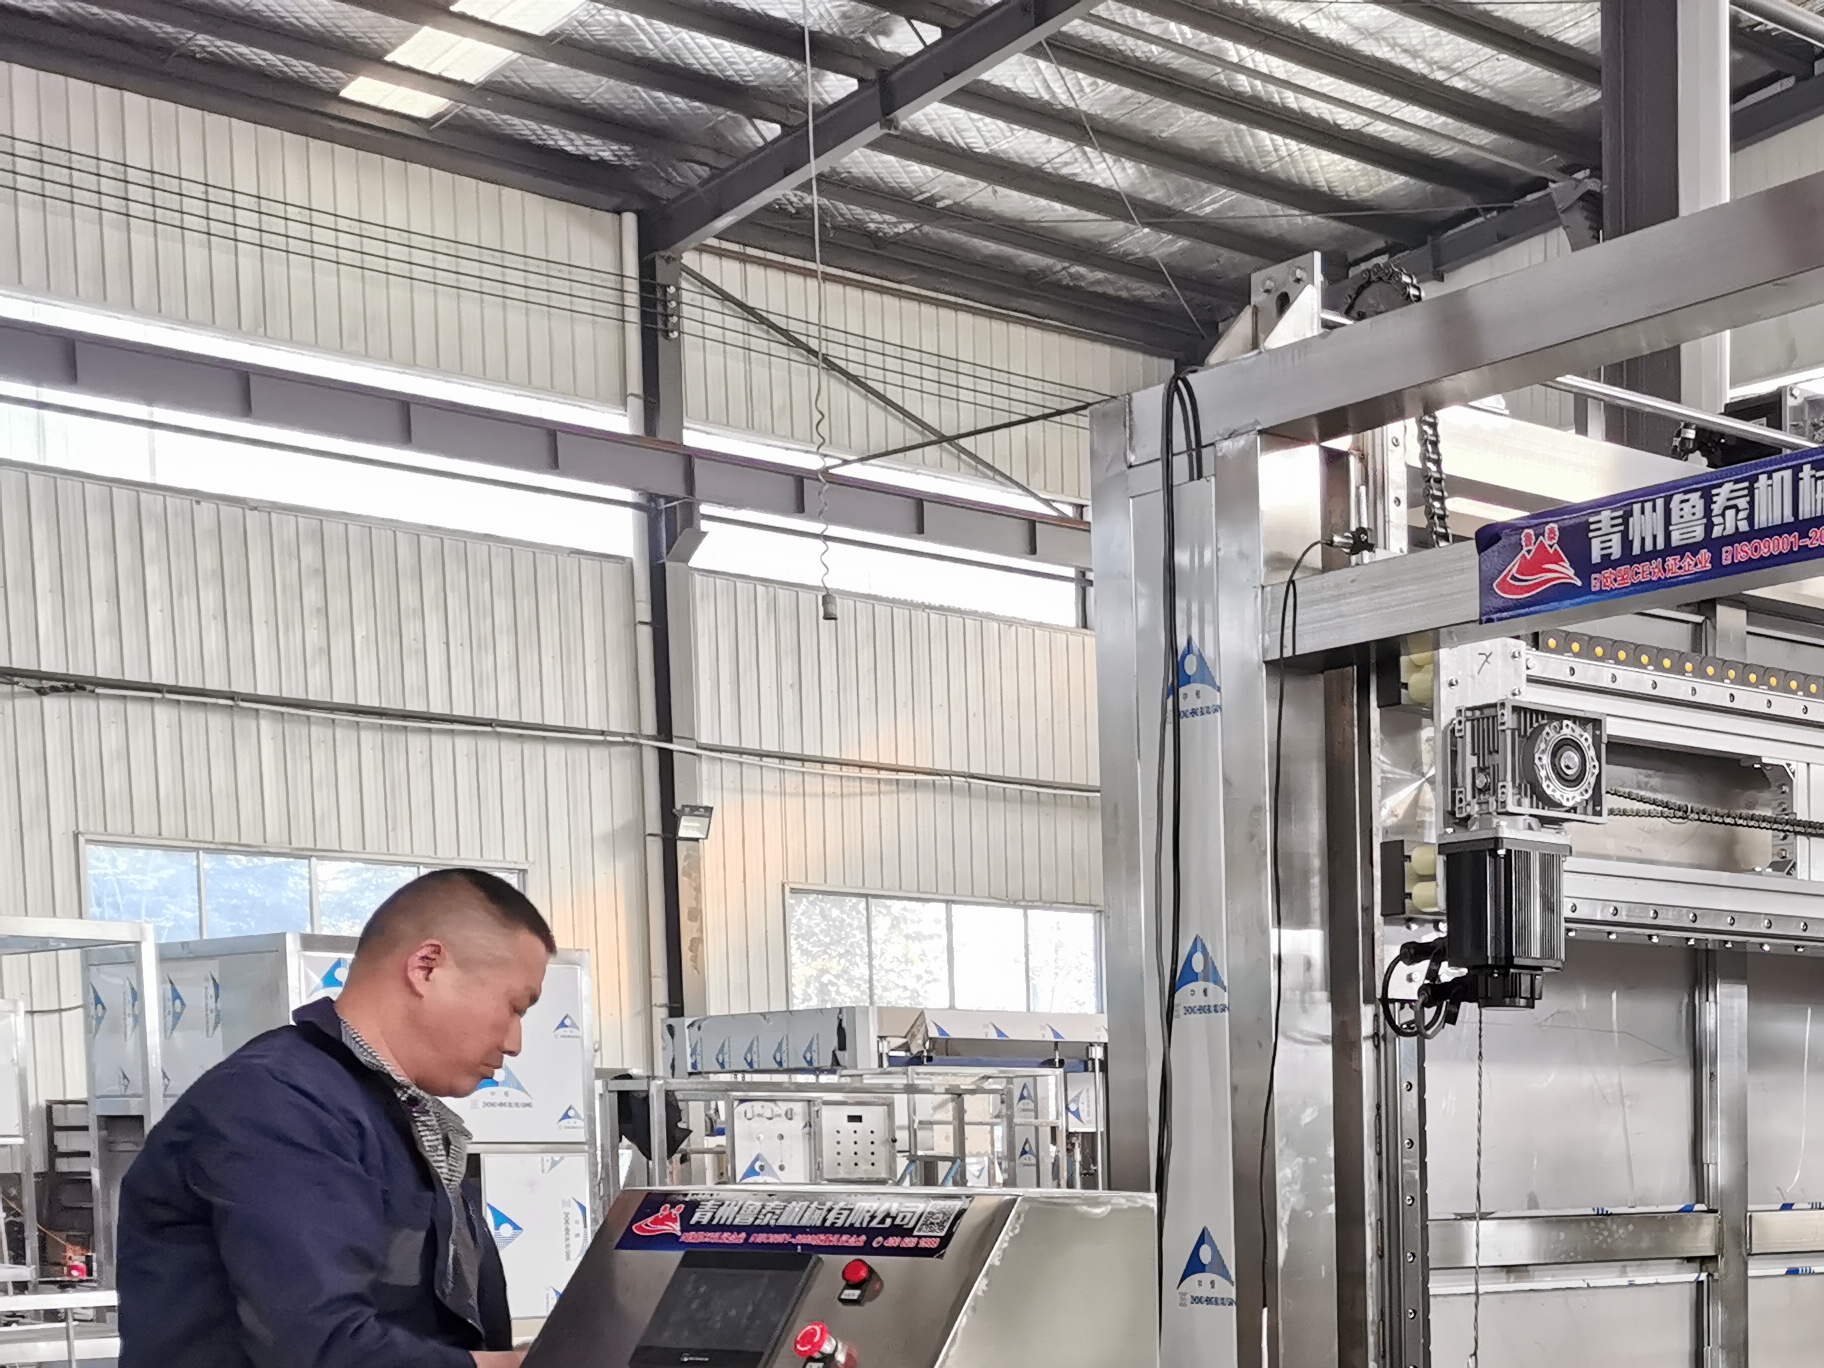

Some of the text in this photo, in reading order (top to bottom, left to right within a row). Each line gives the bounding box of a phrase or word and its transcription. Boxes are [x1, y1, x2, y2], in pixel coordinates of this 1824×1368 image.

[1601, 549, 1712, 591] 欧盟CE认证企业
[690, 1200, 926, 1229] 青州鲁泰机械有限公司
